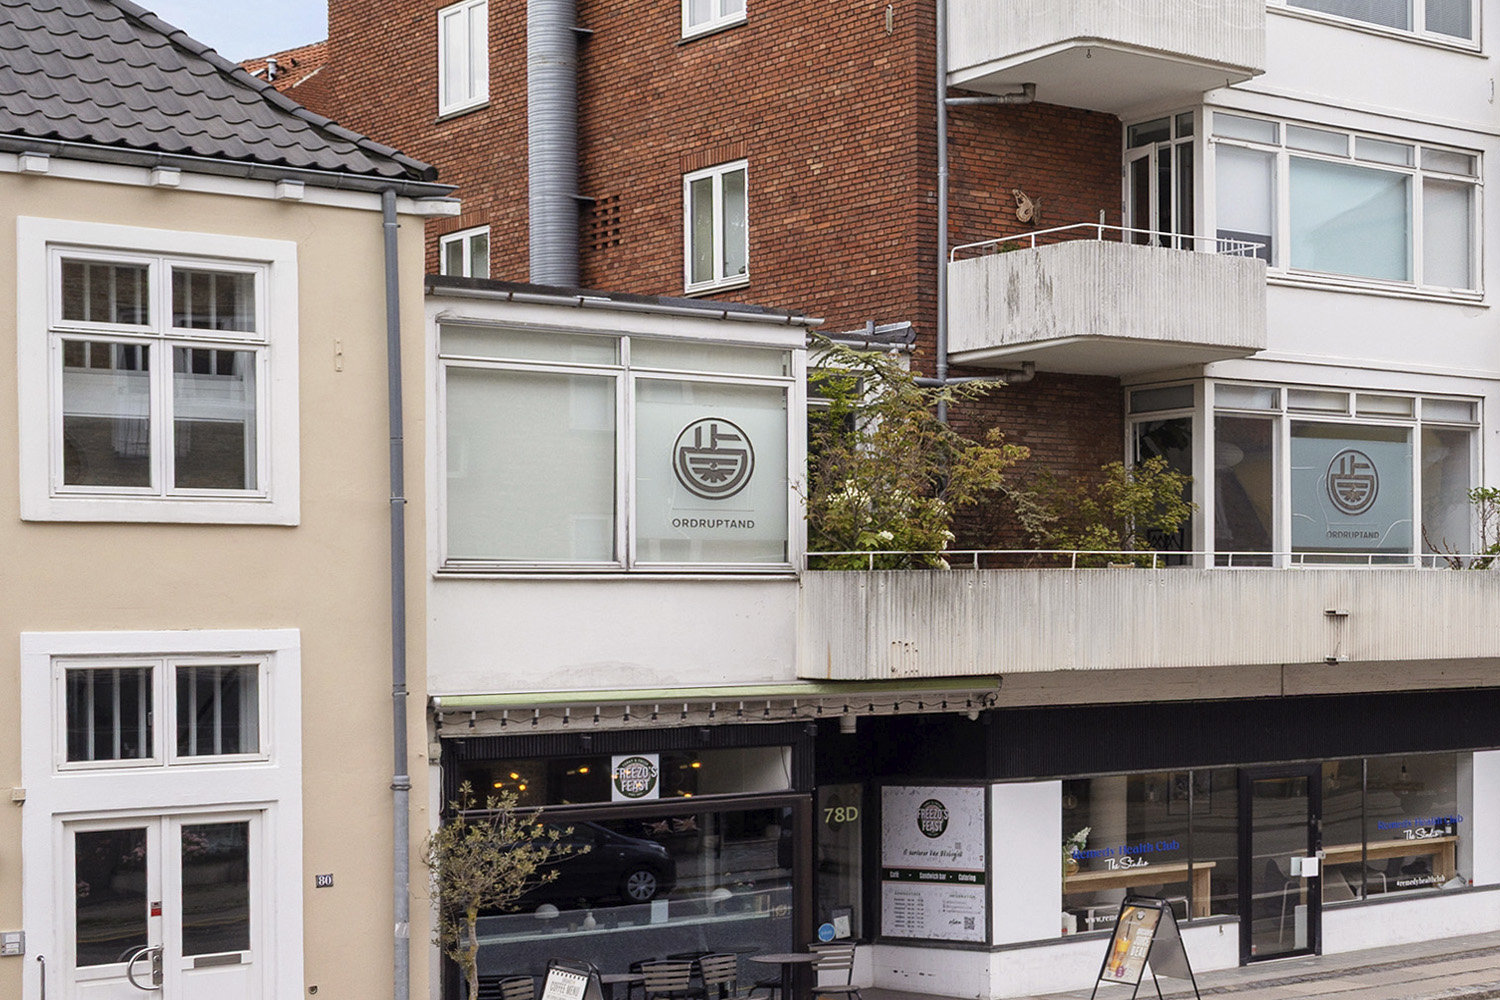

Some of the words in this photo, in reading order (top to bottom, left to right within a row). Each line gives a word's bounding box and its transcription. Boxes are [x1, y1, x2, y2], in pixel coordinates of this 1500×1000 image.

[672, 518, 755, 529] ORDRUPTAND
[1327, 530, 1380, 539] ORDRUPTAND
[614, 766, 657, 779] FREEZO'S
[621, 780, 649, 792] FEAST
[823, 806, 859, 824] 78D
[922, 820, 943, 832] FEAST
[1414, 816, 1443, 827] Health
[1403, 829, 1415, 840] The
[1072, 847, 1115, 860] Remedy
[1119, 842, 1154, 856] Health
[1155, 839, 1180, 852] Club
[1104, 858, 1119, 870] The
[1119, 856, 1150, 870] Studio
[318, 875, 331, 886] 80
[958, 873, 976, 882] Catering
[1396, 875, 1446, 887] #remedyhealthclub
